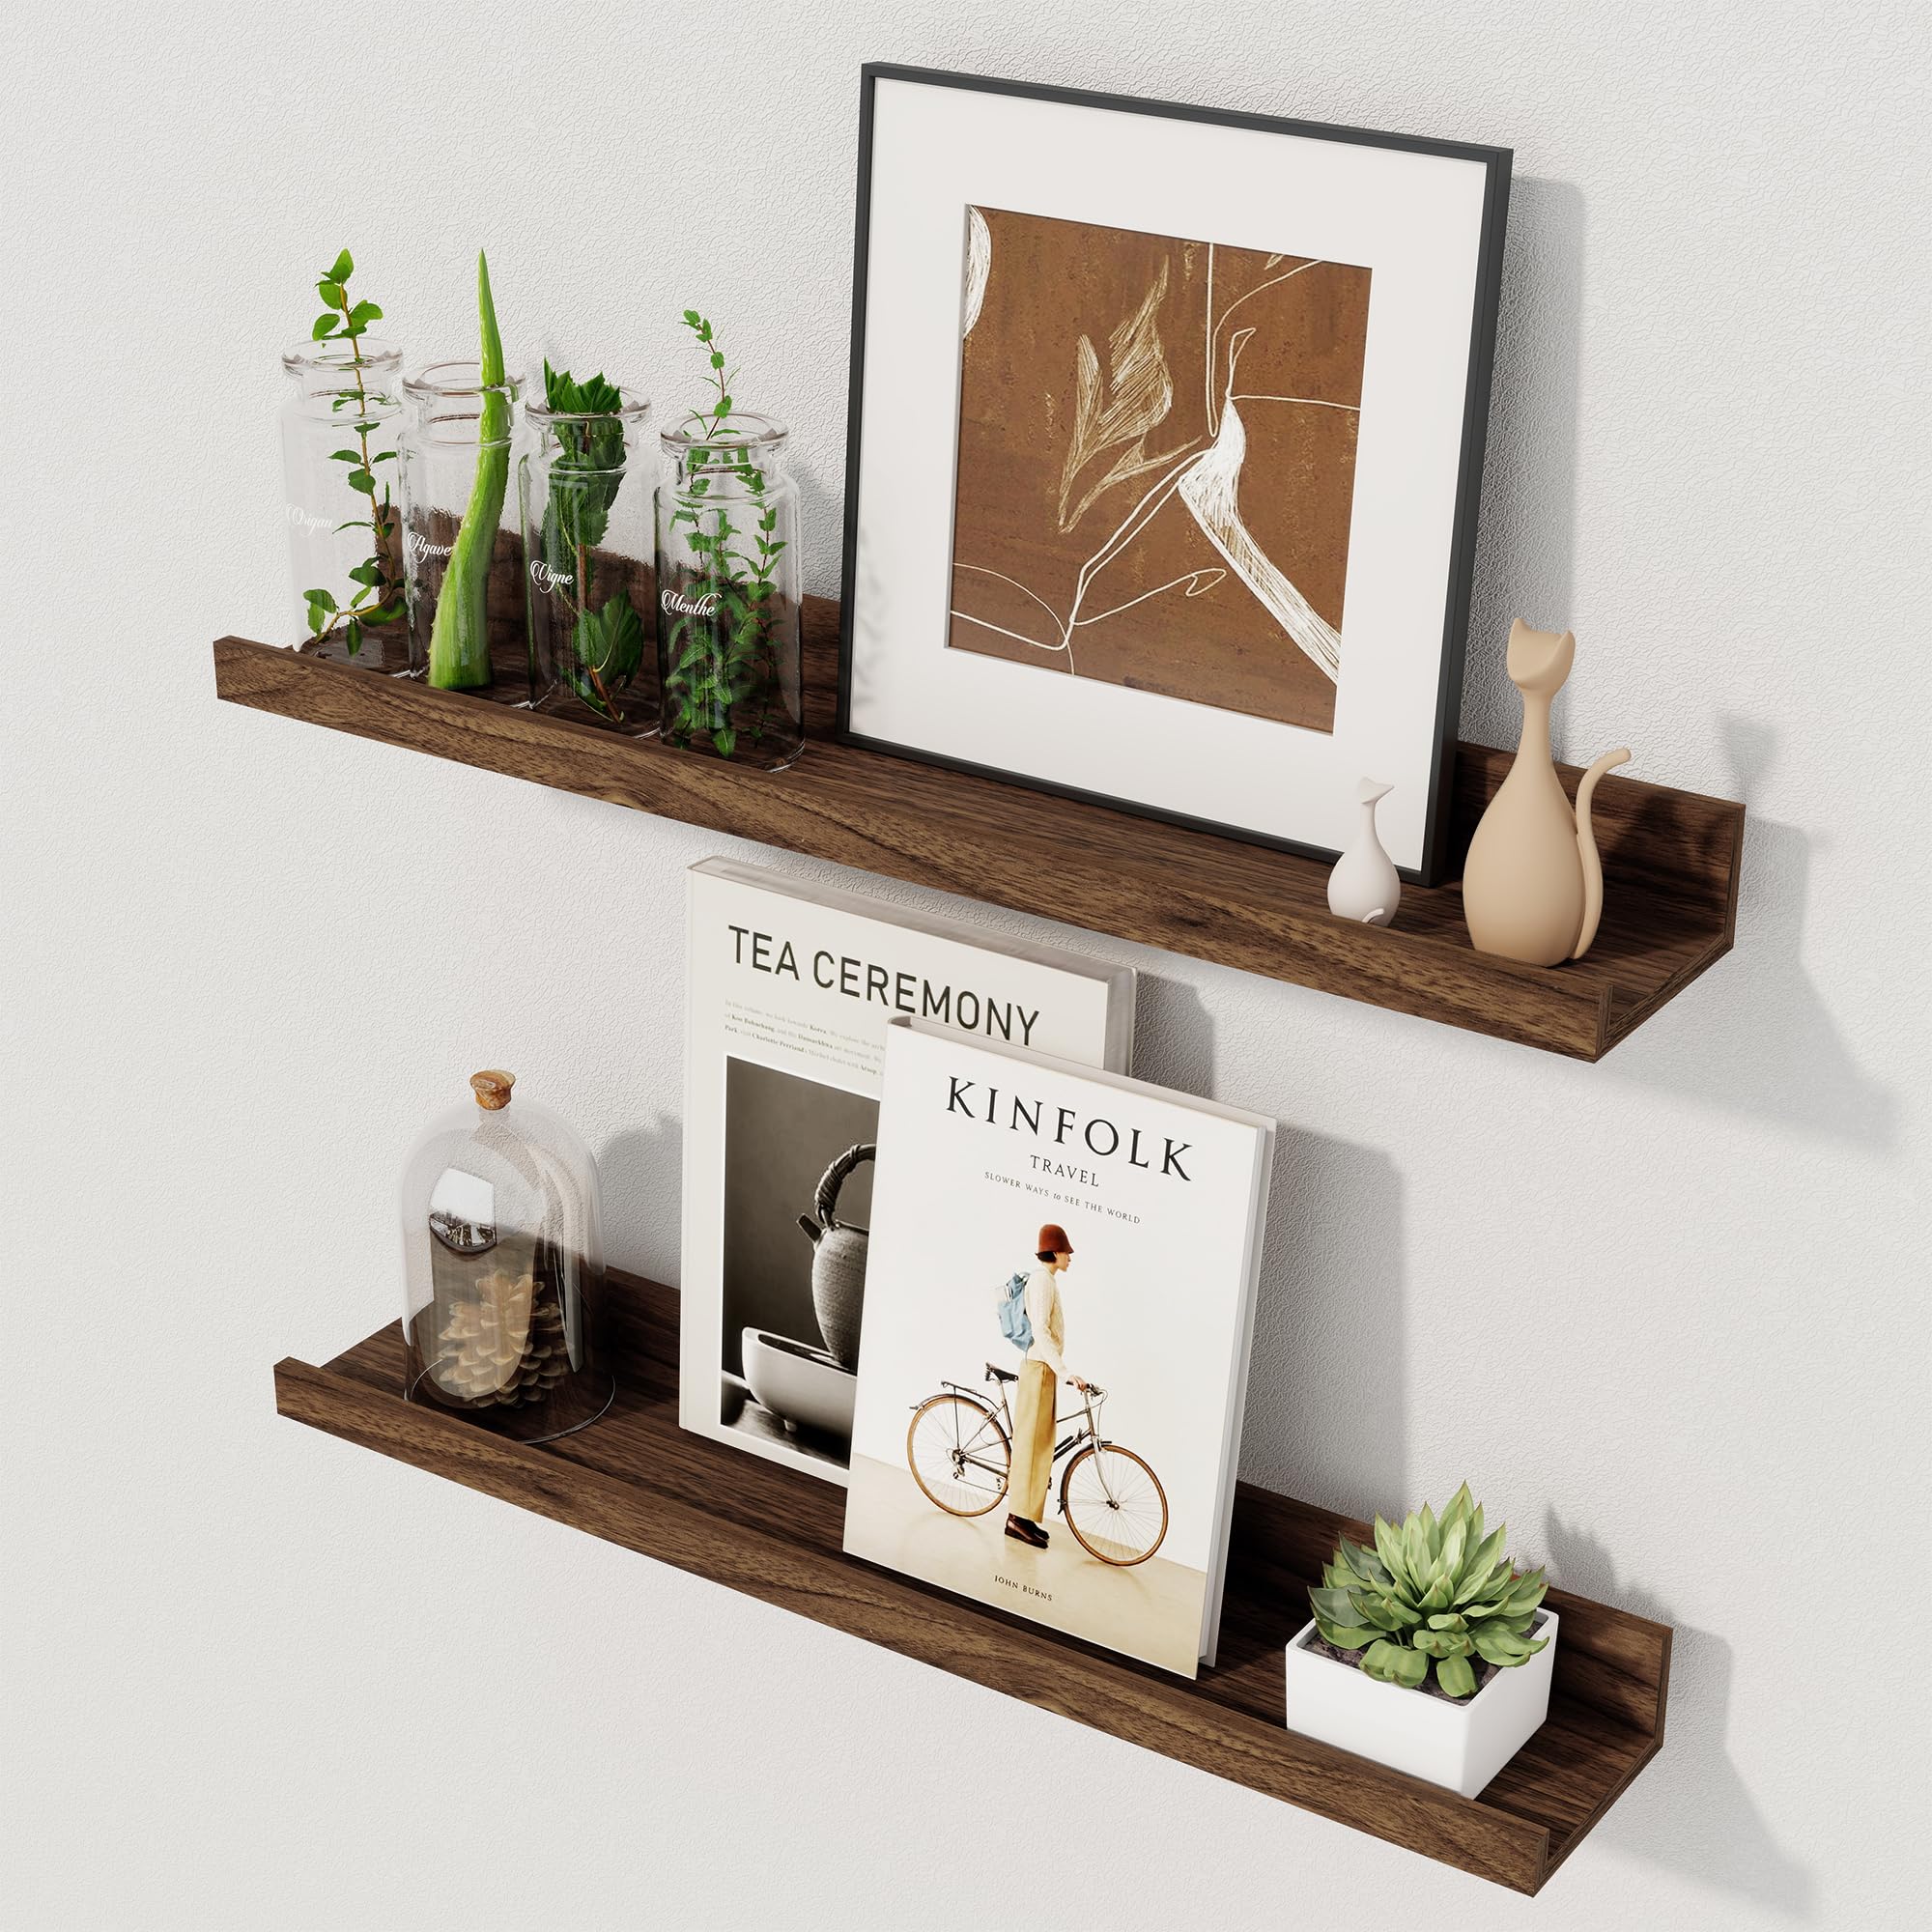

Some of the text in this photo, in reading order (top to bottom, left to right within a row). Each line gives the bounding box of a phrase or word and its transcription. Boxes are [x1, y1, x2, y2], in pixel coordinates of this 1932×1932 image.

[408, 531, 454, 564] Agave
[530, 560, 575, 594] Vigne
[661, 589, 723, 616] Menthe
[728, 924, 1040, 1046] TEA CEREMONY
[946, 1075, 1193, 1181] KINFOLK
[1030, 1154, 1099, 1187] TRAVEL
[984, 1171, 1021, 1188] SLOWER
[1025, 1182, 1049, 1197] WAYS
[1064, 1196, 1080, 1207] SEE
[1085, 1201, 1103, 1213] THE
[1107, 1208, 1141, 1224] WORLD
[994, 1575, 1053, 1602] JOHN BURNS
